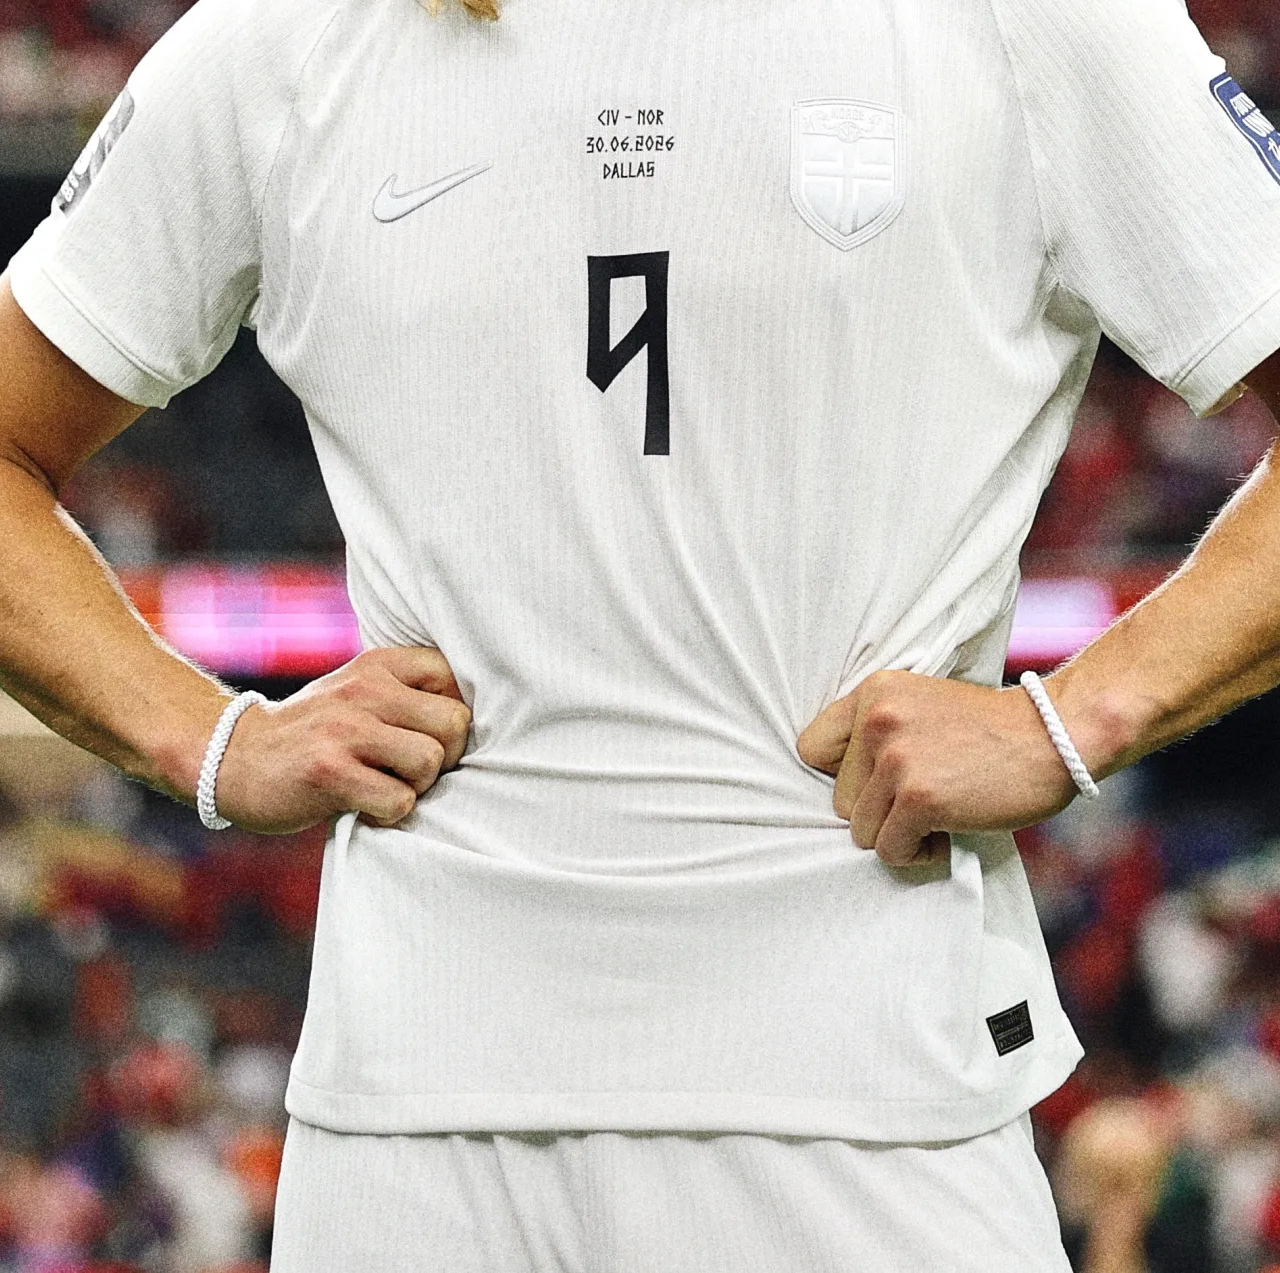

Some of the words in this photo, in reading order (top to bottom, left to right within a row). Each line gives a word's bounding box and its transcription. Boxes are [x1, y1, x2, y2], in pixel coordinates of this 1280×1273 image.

[597, 109, 620, 126] CIV
[637, 109, 665, 126] NOR
[586, 135, 675, 154] 30.06.2026
[603, 161, 656, 180] DALLAS
[585, 250, 671, 457] 9
